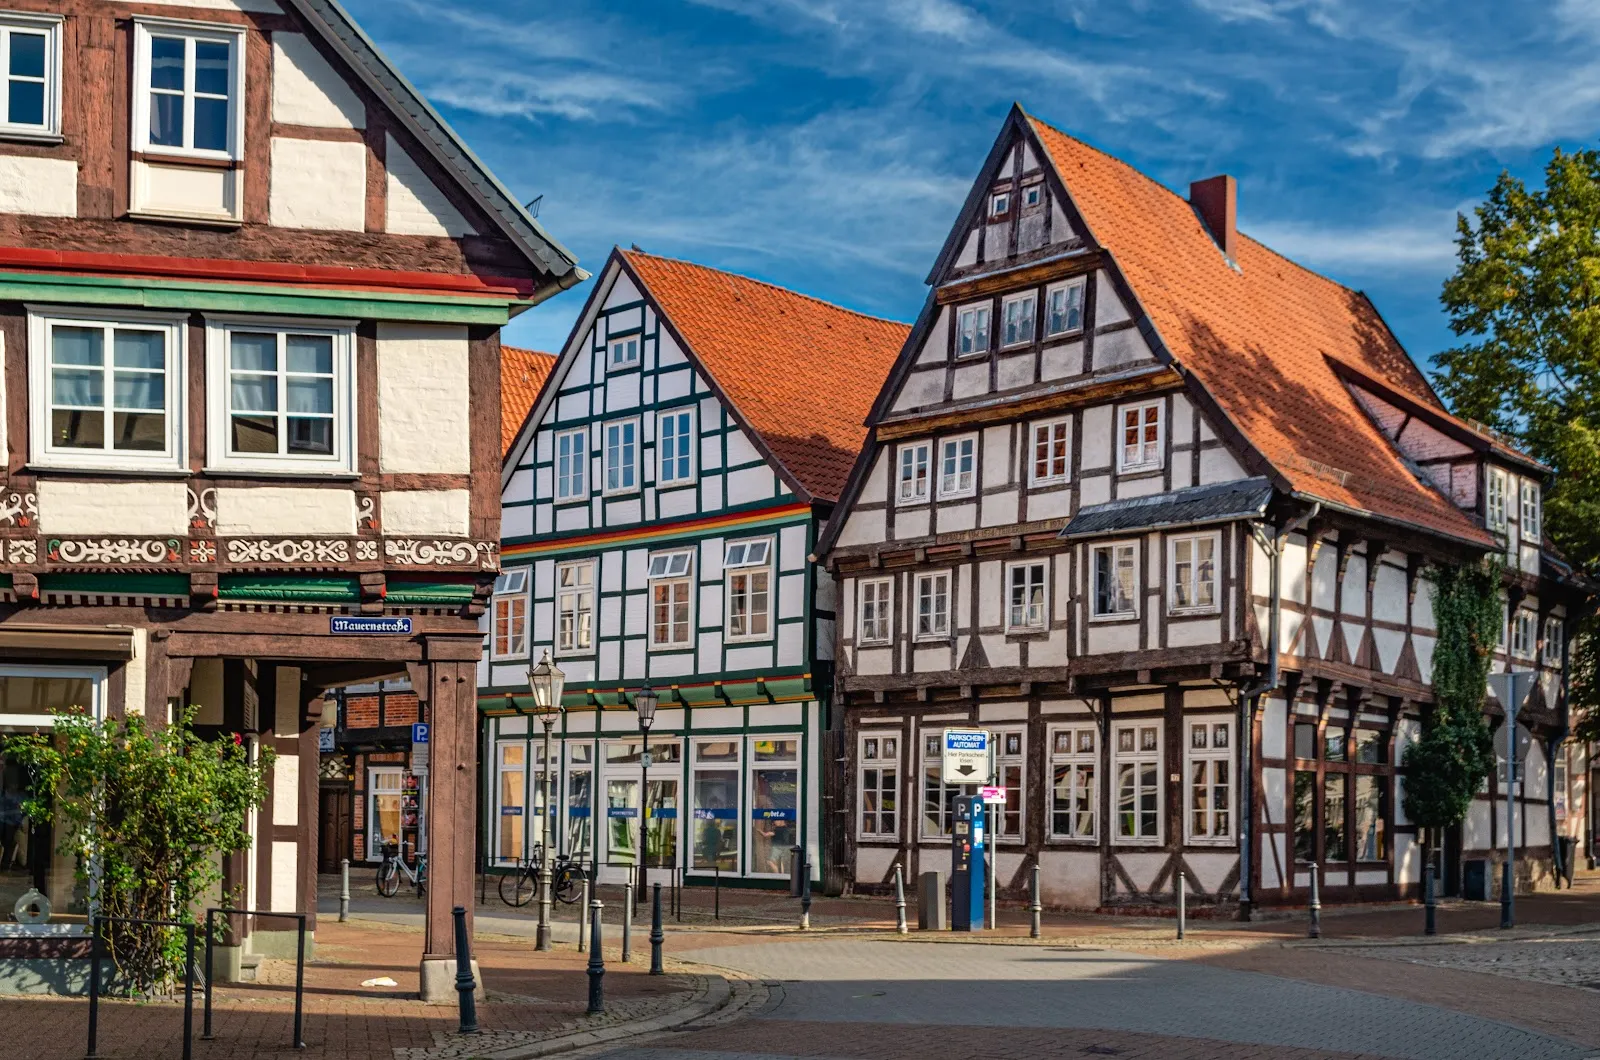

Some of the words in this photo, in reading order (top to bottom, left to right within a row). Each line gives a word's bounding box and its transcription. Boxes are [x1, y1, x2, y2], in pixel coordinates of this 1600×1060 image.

[334, 619, 408, 632] Mauernstraße
[417, 726, 427, 740] P
[948, 734, 985, 742] PARKSCHEIN-
[953, 741, 981, 749] AUTOMAT
[763, 810, 785, 819] mybet.de
[958, 803, 966, 817] P
[974, 803, 982, 817] P
